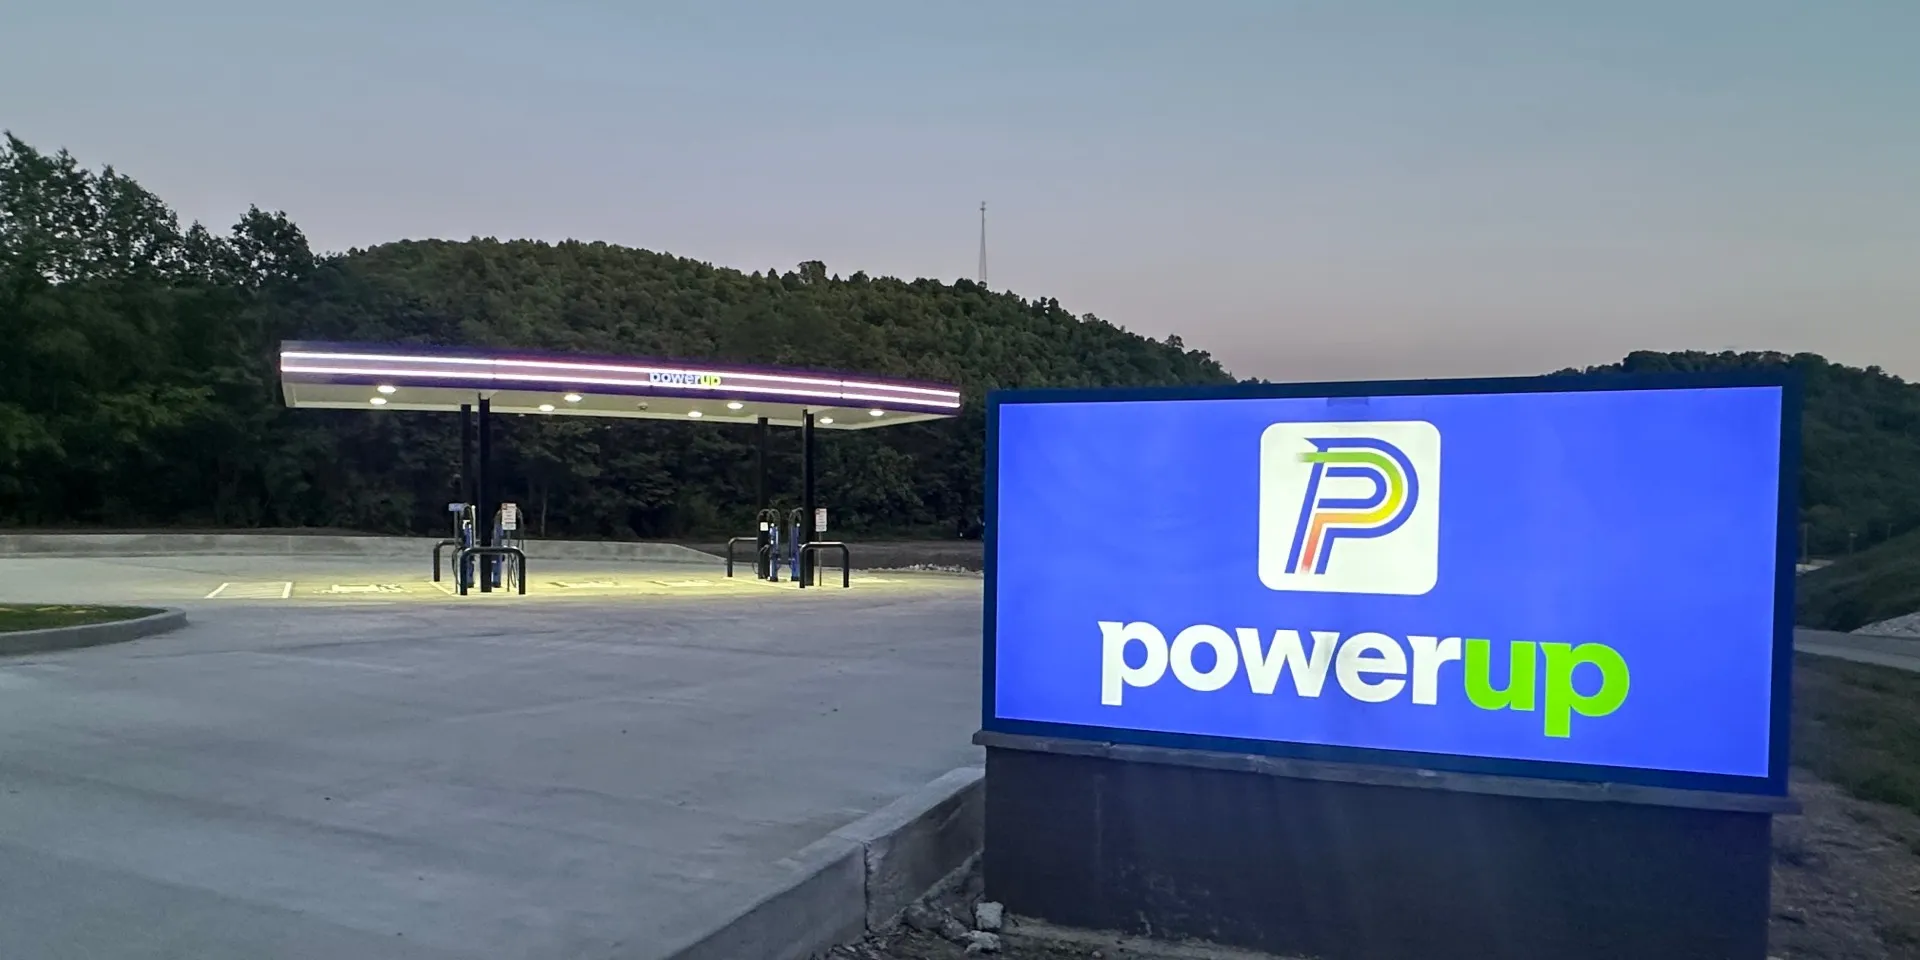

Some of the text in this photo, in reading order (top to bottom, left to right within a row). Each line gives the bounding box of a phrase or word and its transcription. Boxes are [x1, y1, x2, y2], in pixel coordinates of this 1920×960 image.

[649, 372, 722, 388] powerup
[1284, 437, 1419, 574] P
[1098, 620, 1630, 738] powerup
